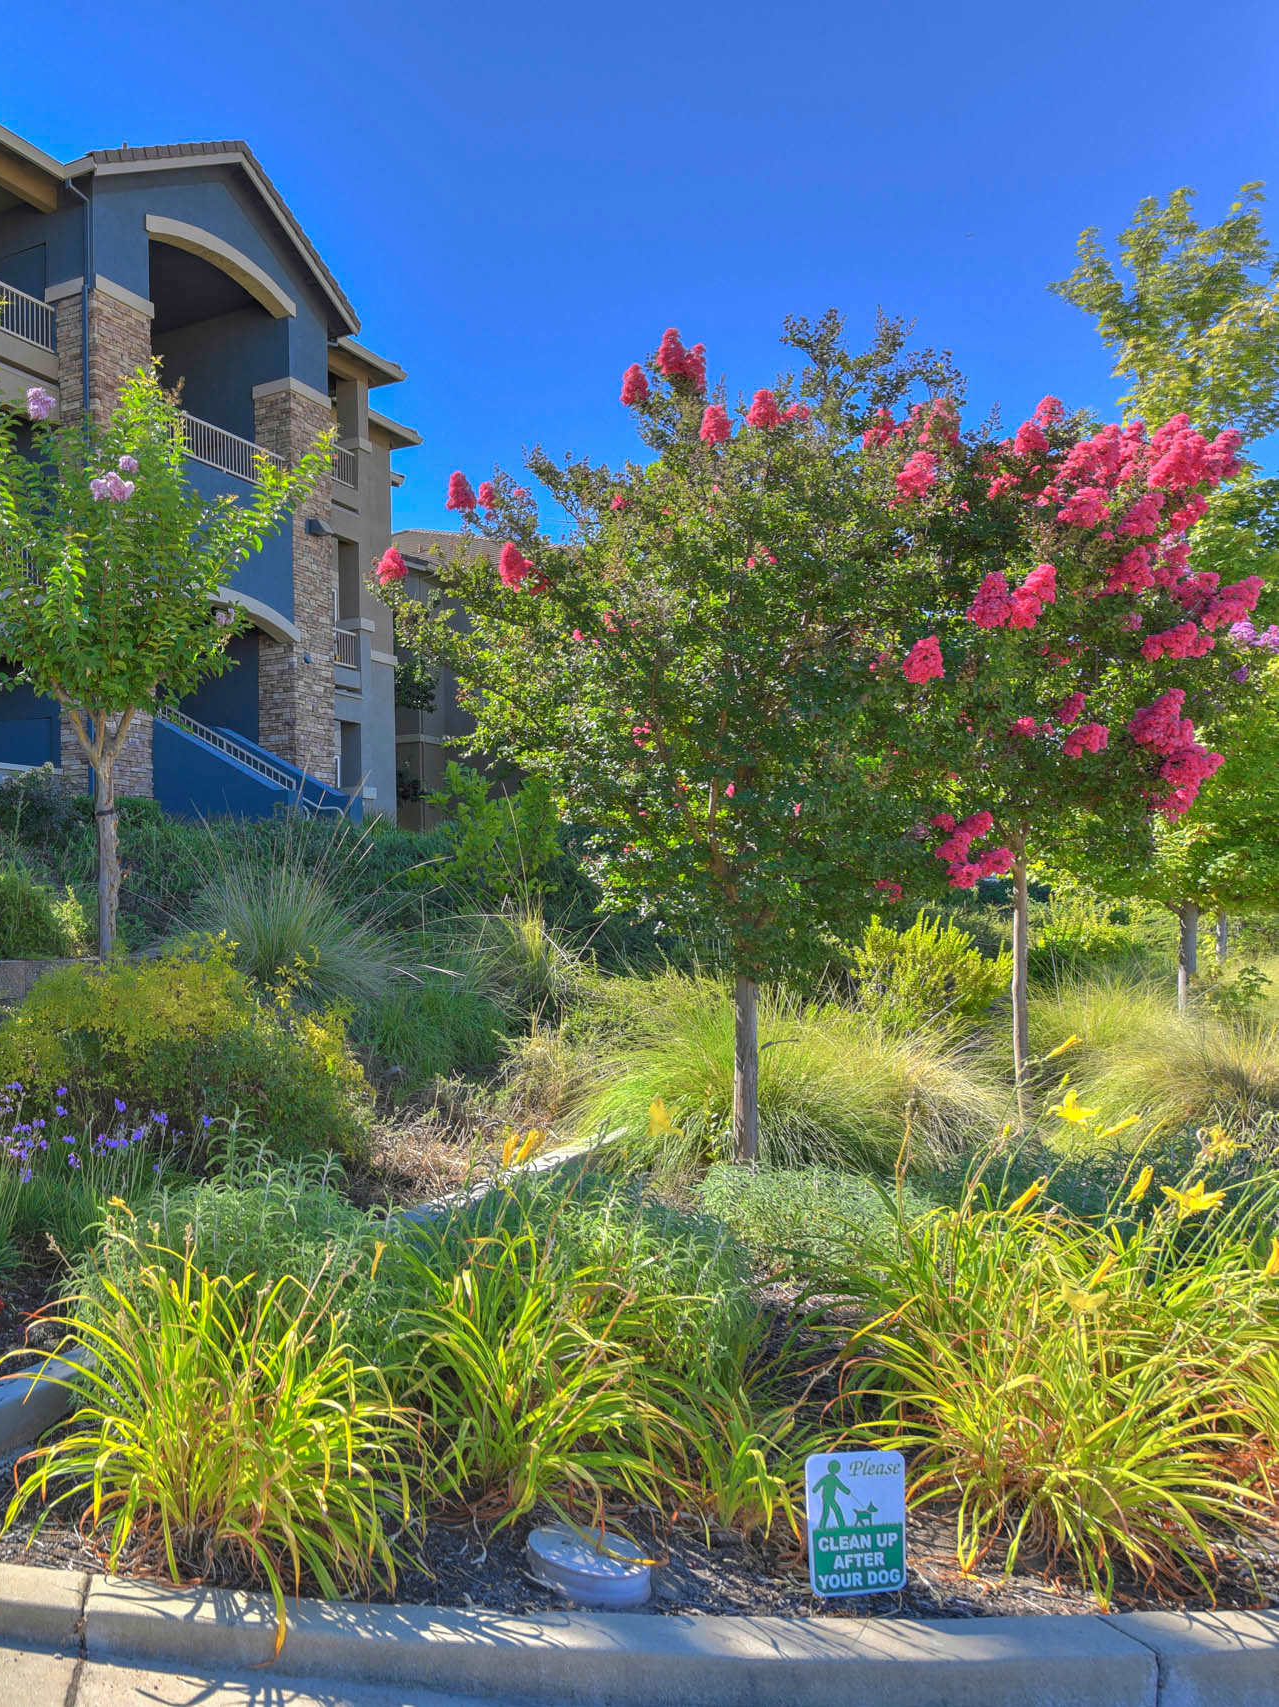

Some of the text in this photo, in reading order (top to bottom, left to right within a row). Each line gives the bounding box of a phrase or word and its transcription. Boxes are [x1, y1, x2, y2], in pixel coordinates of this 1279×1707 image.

[850, 1458, 901, 1476] Please
[818, 1532, 898, 1552] CLEAN UP
[834, 1551, 885, 1570] AFTER
[818, 1569, 901, 1590] YOUR DOG
